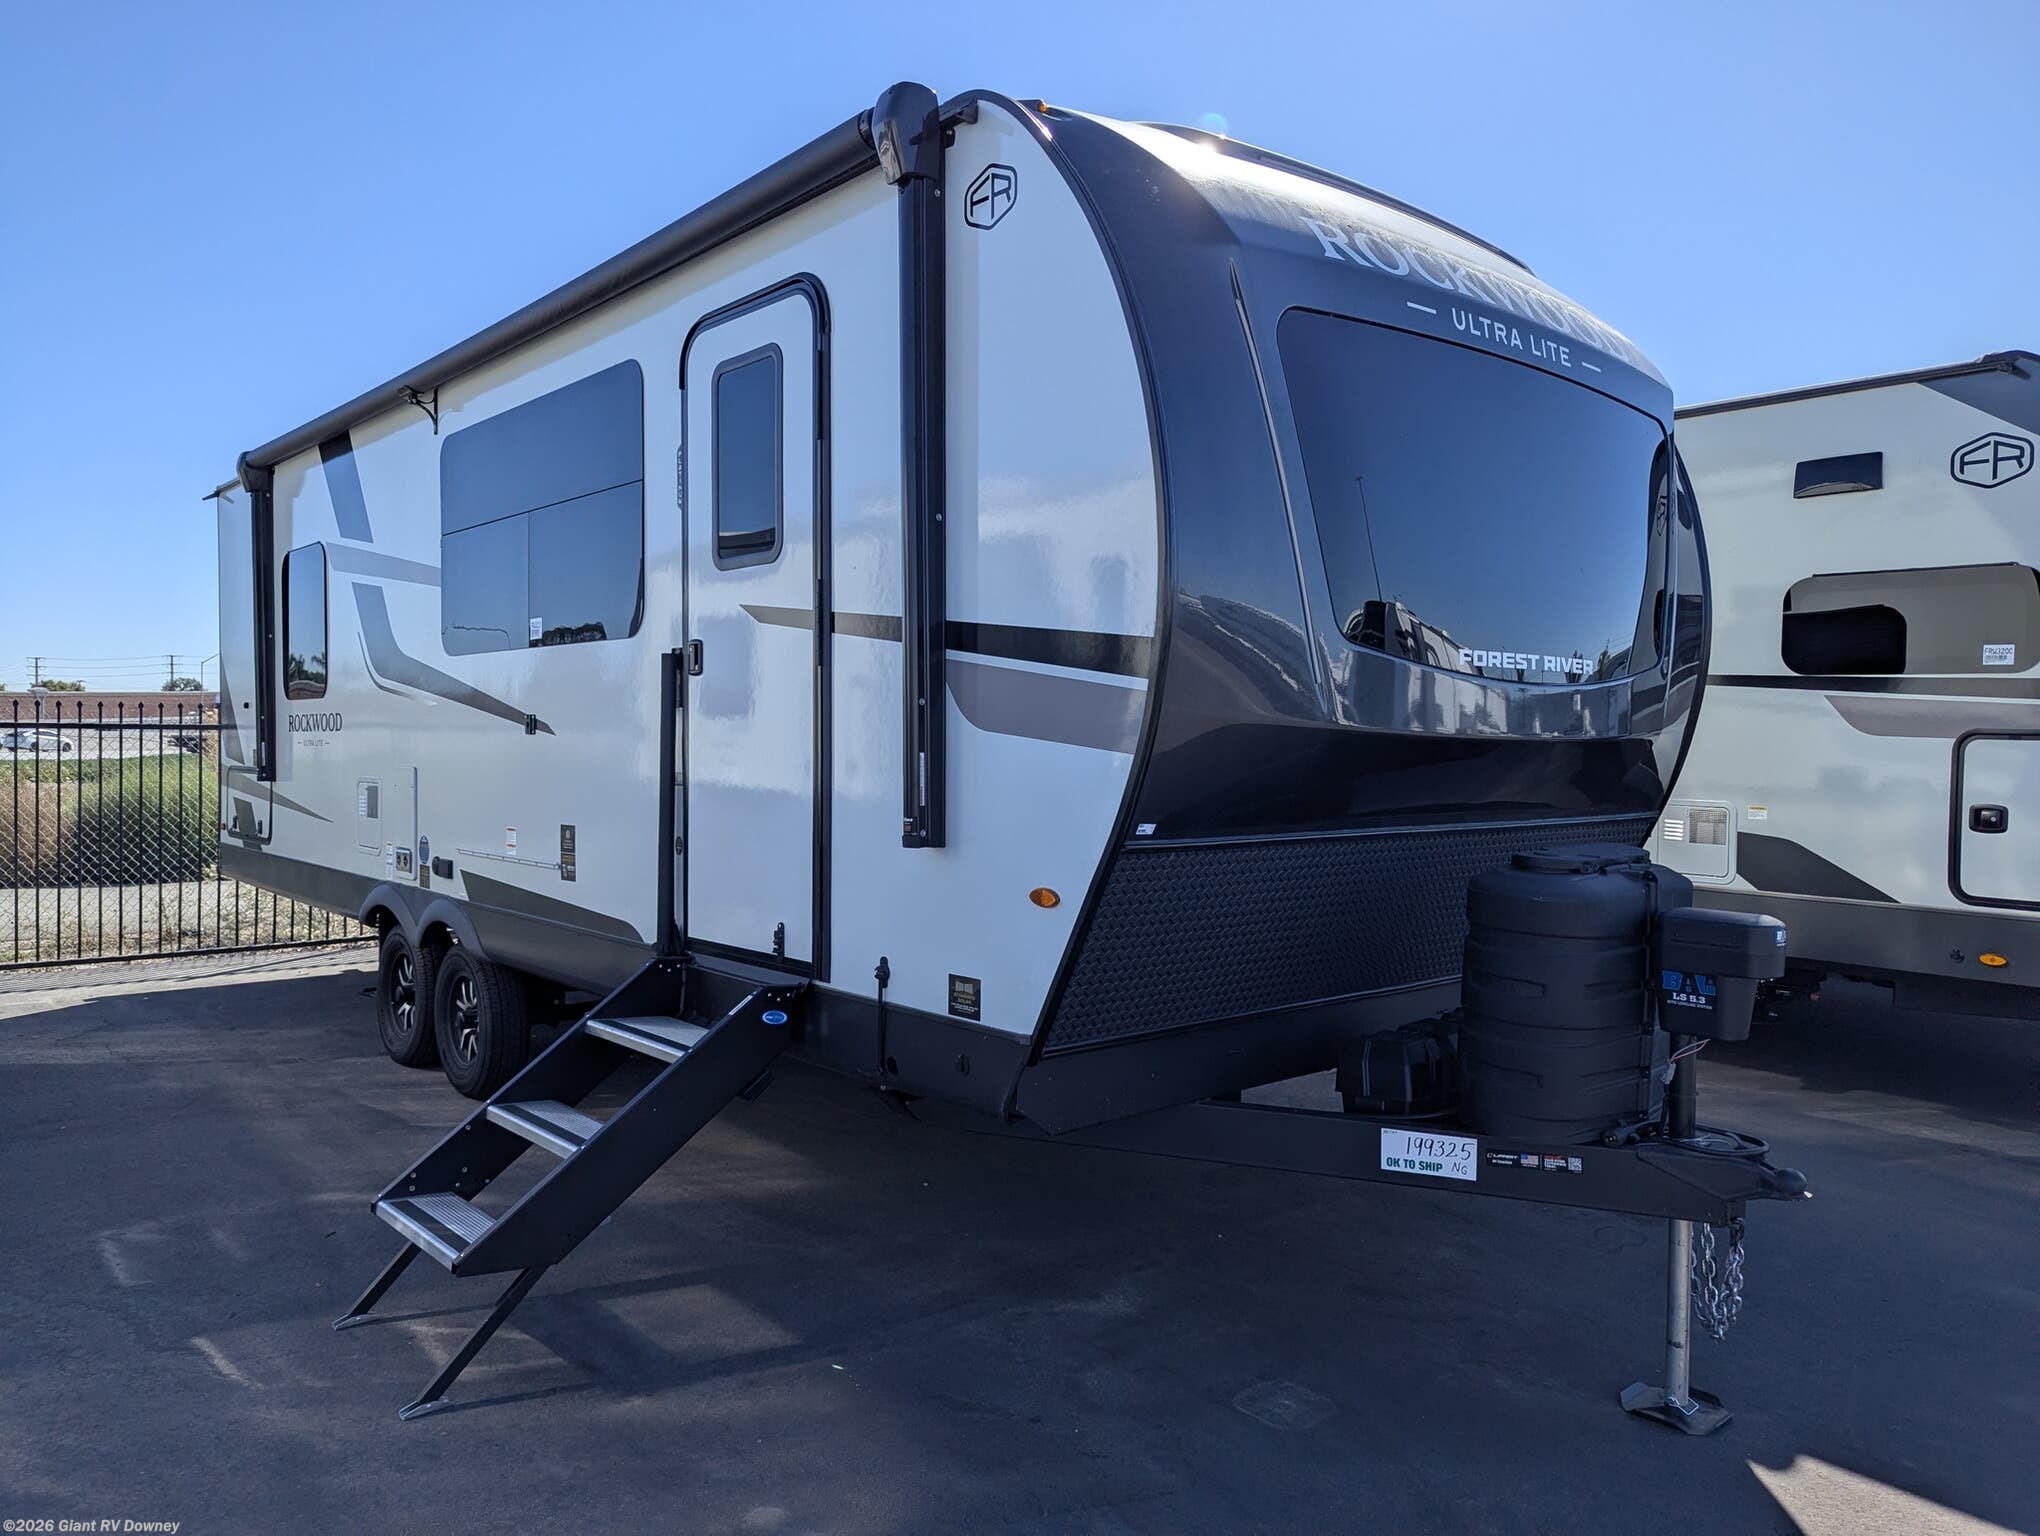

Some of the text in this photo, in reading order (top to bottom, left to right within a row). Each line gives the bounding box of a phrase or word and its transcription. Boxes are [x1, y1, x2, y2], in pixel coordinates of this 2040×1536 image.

[1451, 307, 1572, 368] ULTRA LITE
[1459, 649, 1594, 675] FOREST RIVER
[288, 713, 343, 732] ROCKWOOD
[1672, 992, 1706, 1004] LS 5.3
[1406, 1136, 1475, 1161] 199325
[1386, 1156, 1443, 1173] OK TO SHIP
